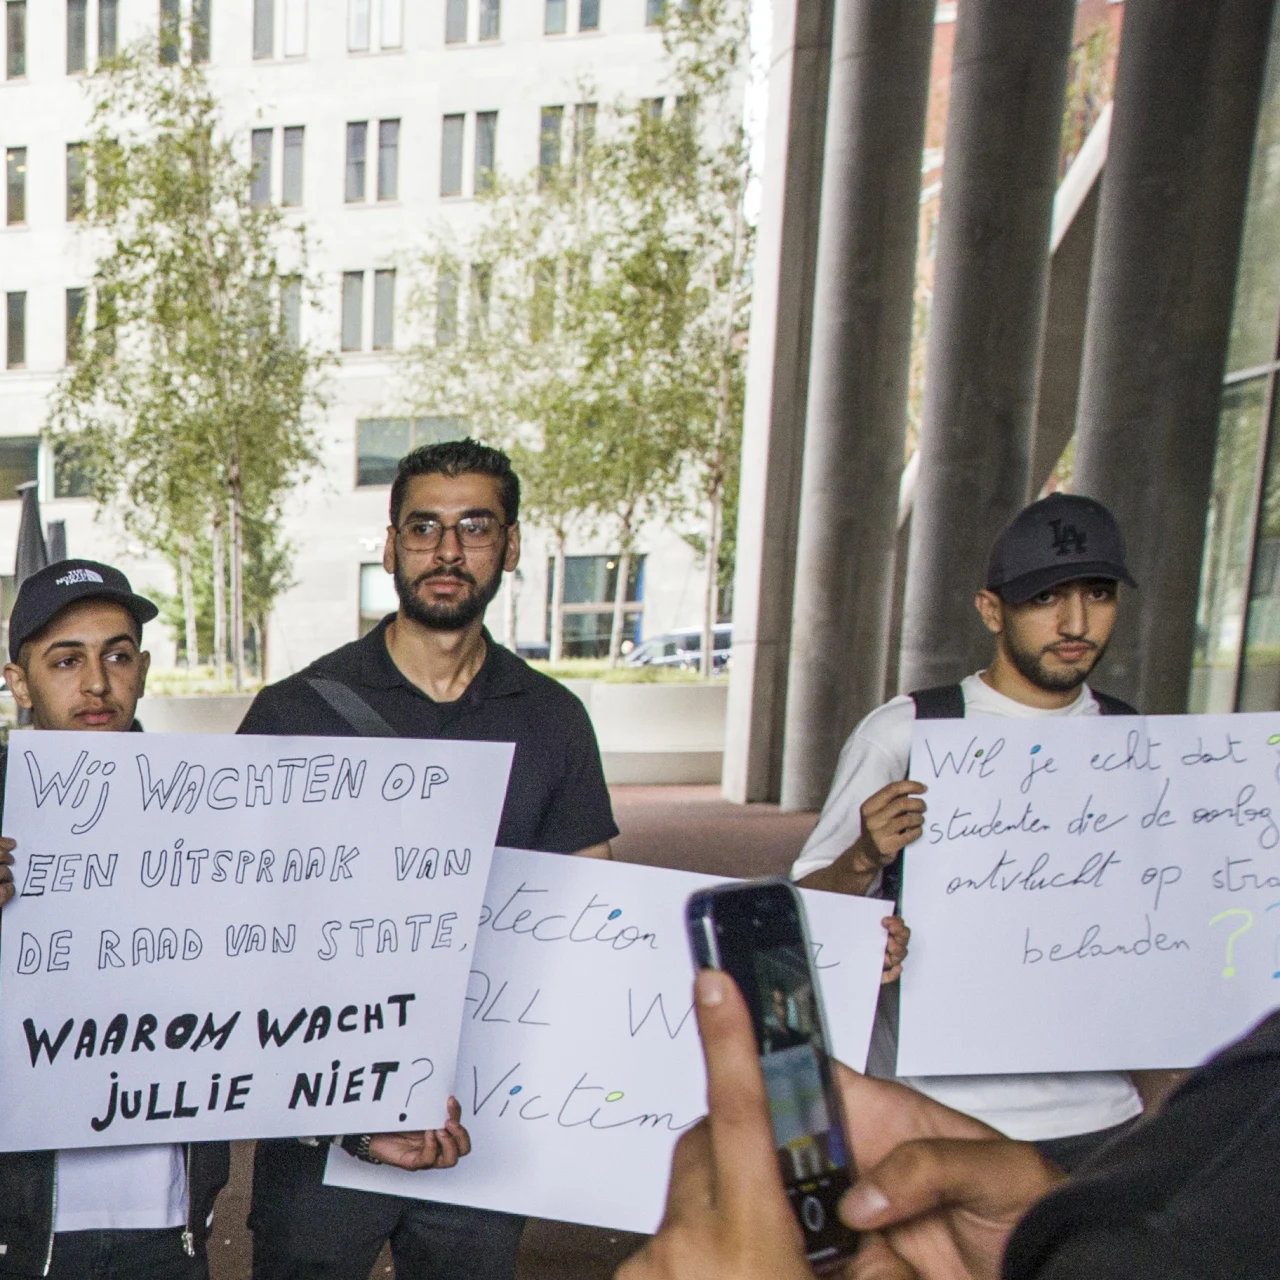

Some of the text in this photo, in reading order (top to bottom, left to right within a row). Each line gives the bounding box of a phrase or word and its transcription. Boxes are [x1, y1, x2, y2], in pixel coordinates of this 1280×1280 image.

[136, 753, 368, 814] WACHTEN
[381, 763, 449, 802] OP
[924, 736, 1006, 778] Wil
[1020, 744, 1058, 793] je
[1090, 730, 1162, 772] echt
[1180, 733, 1248, 766] dat
[929, 796, 1050, 845] studenten
[1067, 794, 1130, 836] die
[1141, 778, 1177, 828] de
[20, 851, 118, 897] EEN
[394, 845, 472, 881] VAN
[946, 850, 1122, 895] ontvlucht
[1140, 865, 1183, 911] op
[17, 911, 469, 975] DE RAAD VAN STATE,
[1023, 914, 1191, 965] belanden
[23, 992, 417, 1068] WAAROM WACHT
